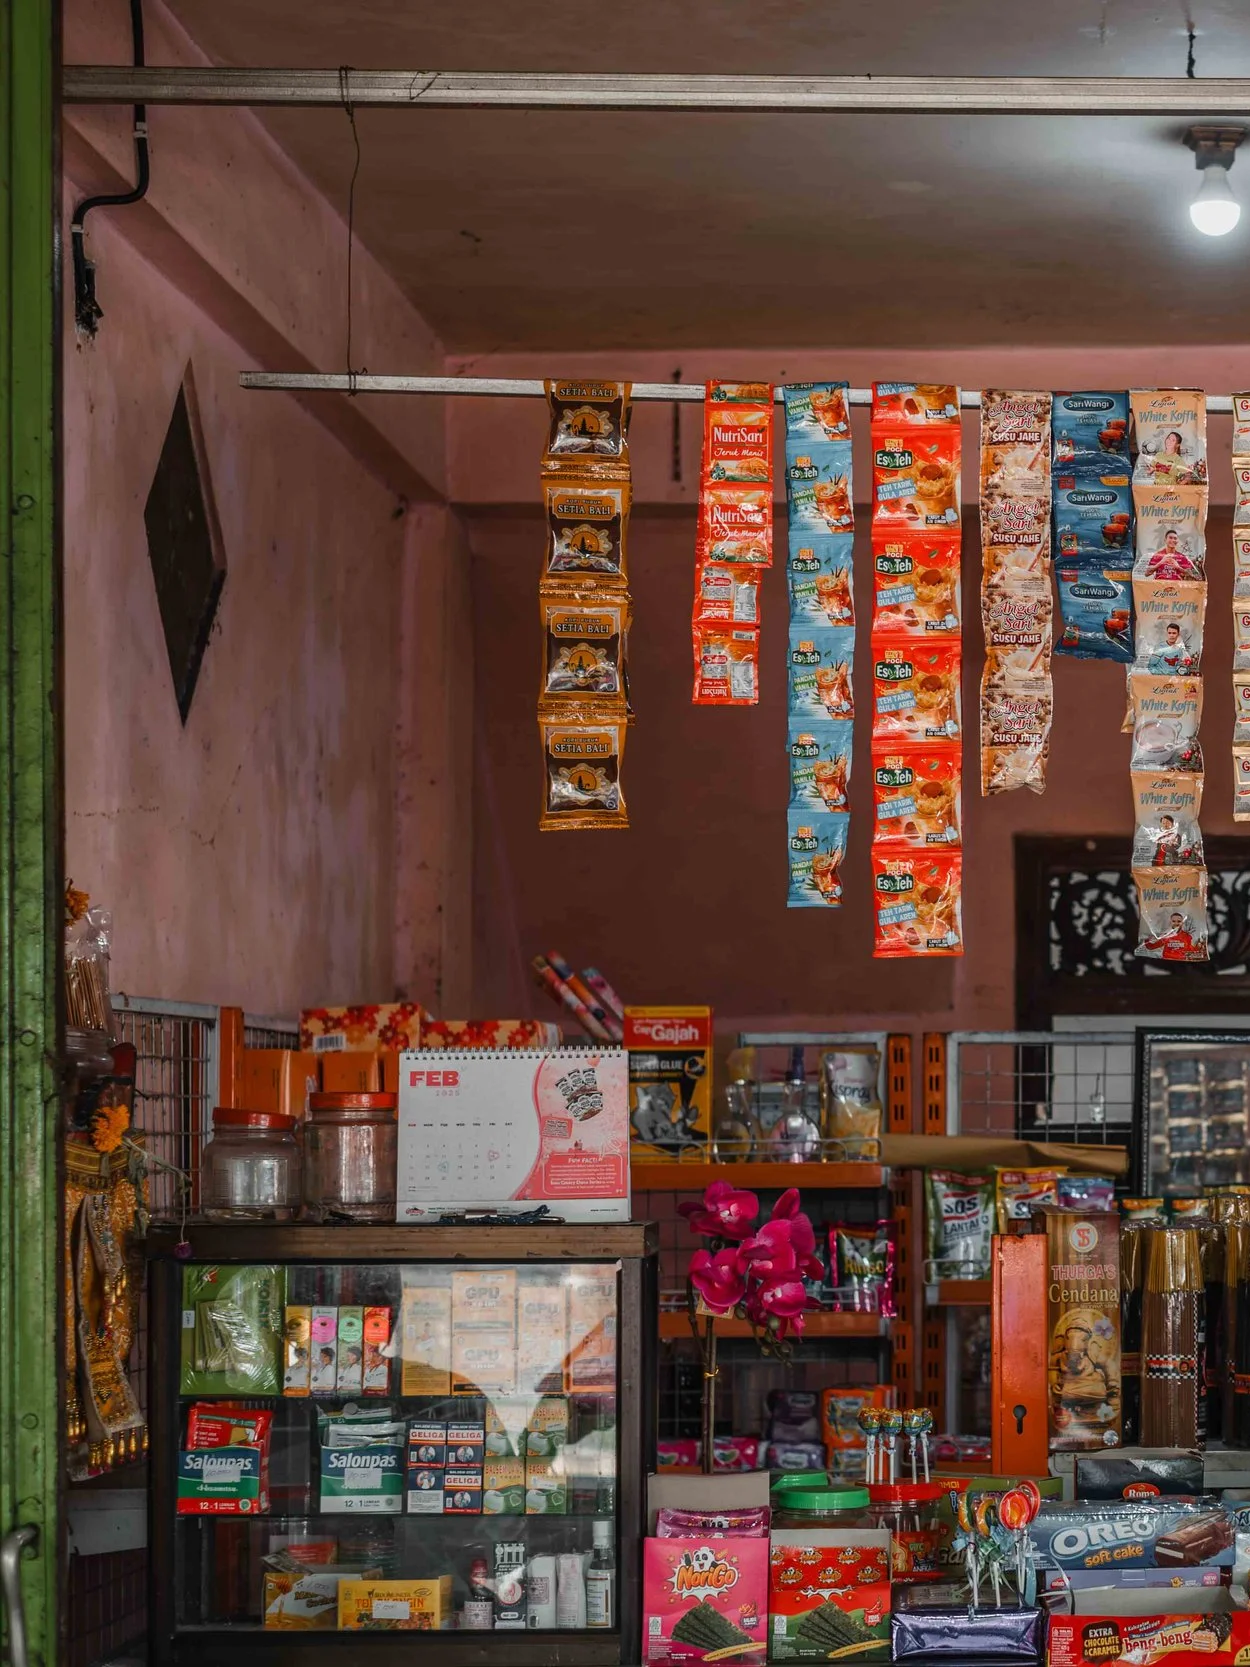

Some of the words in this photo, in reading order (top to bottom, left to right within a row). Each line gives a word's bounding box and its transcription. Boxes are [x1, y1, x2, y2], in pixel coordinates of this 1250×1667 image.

[560, 388, 589, 397] SETIA
[591, 388, 614, 397] BALI
[1068, 400, 1110, 410] SariWangi
[1139, 411, 1168, 423] White
[713, 426, 763, 443] NutriSari
[714, 448, 739, 457] Jeruk
[741, 449, 764, 457] Manis
[876, 456, 889, 466] Es
[895, 455, 912, 466] Teh
[1071, 493, 1113, 503] SariWangi
[557, 505, 586, 514] SETIA
[589, 506, 611, 515] BALI
[712, 506, 763, 524] NutriSari
[1003, 514, 1033, 530] Sari
[993, 533, 1017, 544] SUSU
[1018, 533, 1041, 544] JAHE
[792, 561, 802, 570] Es
[806, 560, 820, 570] Teh
[876, 561, 889, 571] Es
[895, 560, 912, 571] Teh
[878, 590, 893, 599] TEH
[893, 585, 913, 596] TARIK
[1074, 587, 1115, 597] SariWangi
[877, 597, 896, 606] GULA
[898, 593, 916, 602] AREN
[1140, 601, 1170, 613] White
[556, 623, 583, 633] SETIA
[588, 624, 609, 633] BALI
[1003, 616, 1033, 631] Sari
[993, 633, 1017, 644] SUSU
[1018, 634, 1041, 644] JAHE
[792, 654, 802, 663] Es
[806, 653, 820, 662] Teh
[876, 667, 889, 677] Es
[895, 667, 912, 677] Teh
[1140, 699, 1169, 711] White
[554, 743, 582, 753] SETIA
[586, 743, 608, 753] BALI
[877, 772, 889, 782] Es
[895, 772, 912, 783] Teh
[879, 801, 893, 810] TEH
[894, 798, 913, 808] TARIK
[878, 810, 897, 819] GULA
[898, 806, 916, 815] AREN
[877, 878, 889, 888] Es
[896, 877, 912, 889] Teh
[1142, 888, 1170, 901] White
[651, 1024, 699, 1044] Gajah
[409, 1070, 460, 1087] FEB
[1051, 1264, 1116, 1280] THURGA'S
[465, 1285, 500, 1299] GPU
[1048, 1283, 1119, 1303] Cendana
[411, 1431, 444, 1439] GELIGA
[449, 1431, 482, 1439] GELIGA
[184, 1454, 253, 1470] Salonpas
[328, 1452, 397, 1469] Salonpas
[1128, 1489, 1155, 1497] Roma
[1052, 1519, 1154, 1557] OREO
[1083, 1553, 1111, 1568] soft
[1113, 1545, 1145, 1560] cake
[677, 1563, 735, 1590] NoriGo
[1088, 1627, 1113, 1637] EXTRA
[1084, 1636, 1120, 1647] CHOCOLATE
[1123, 1630, 1193, 1653] beng-beng
